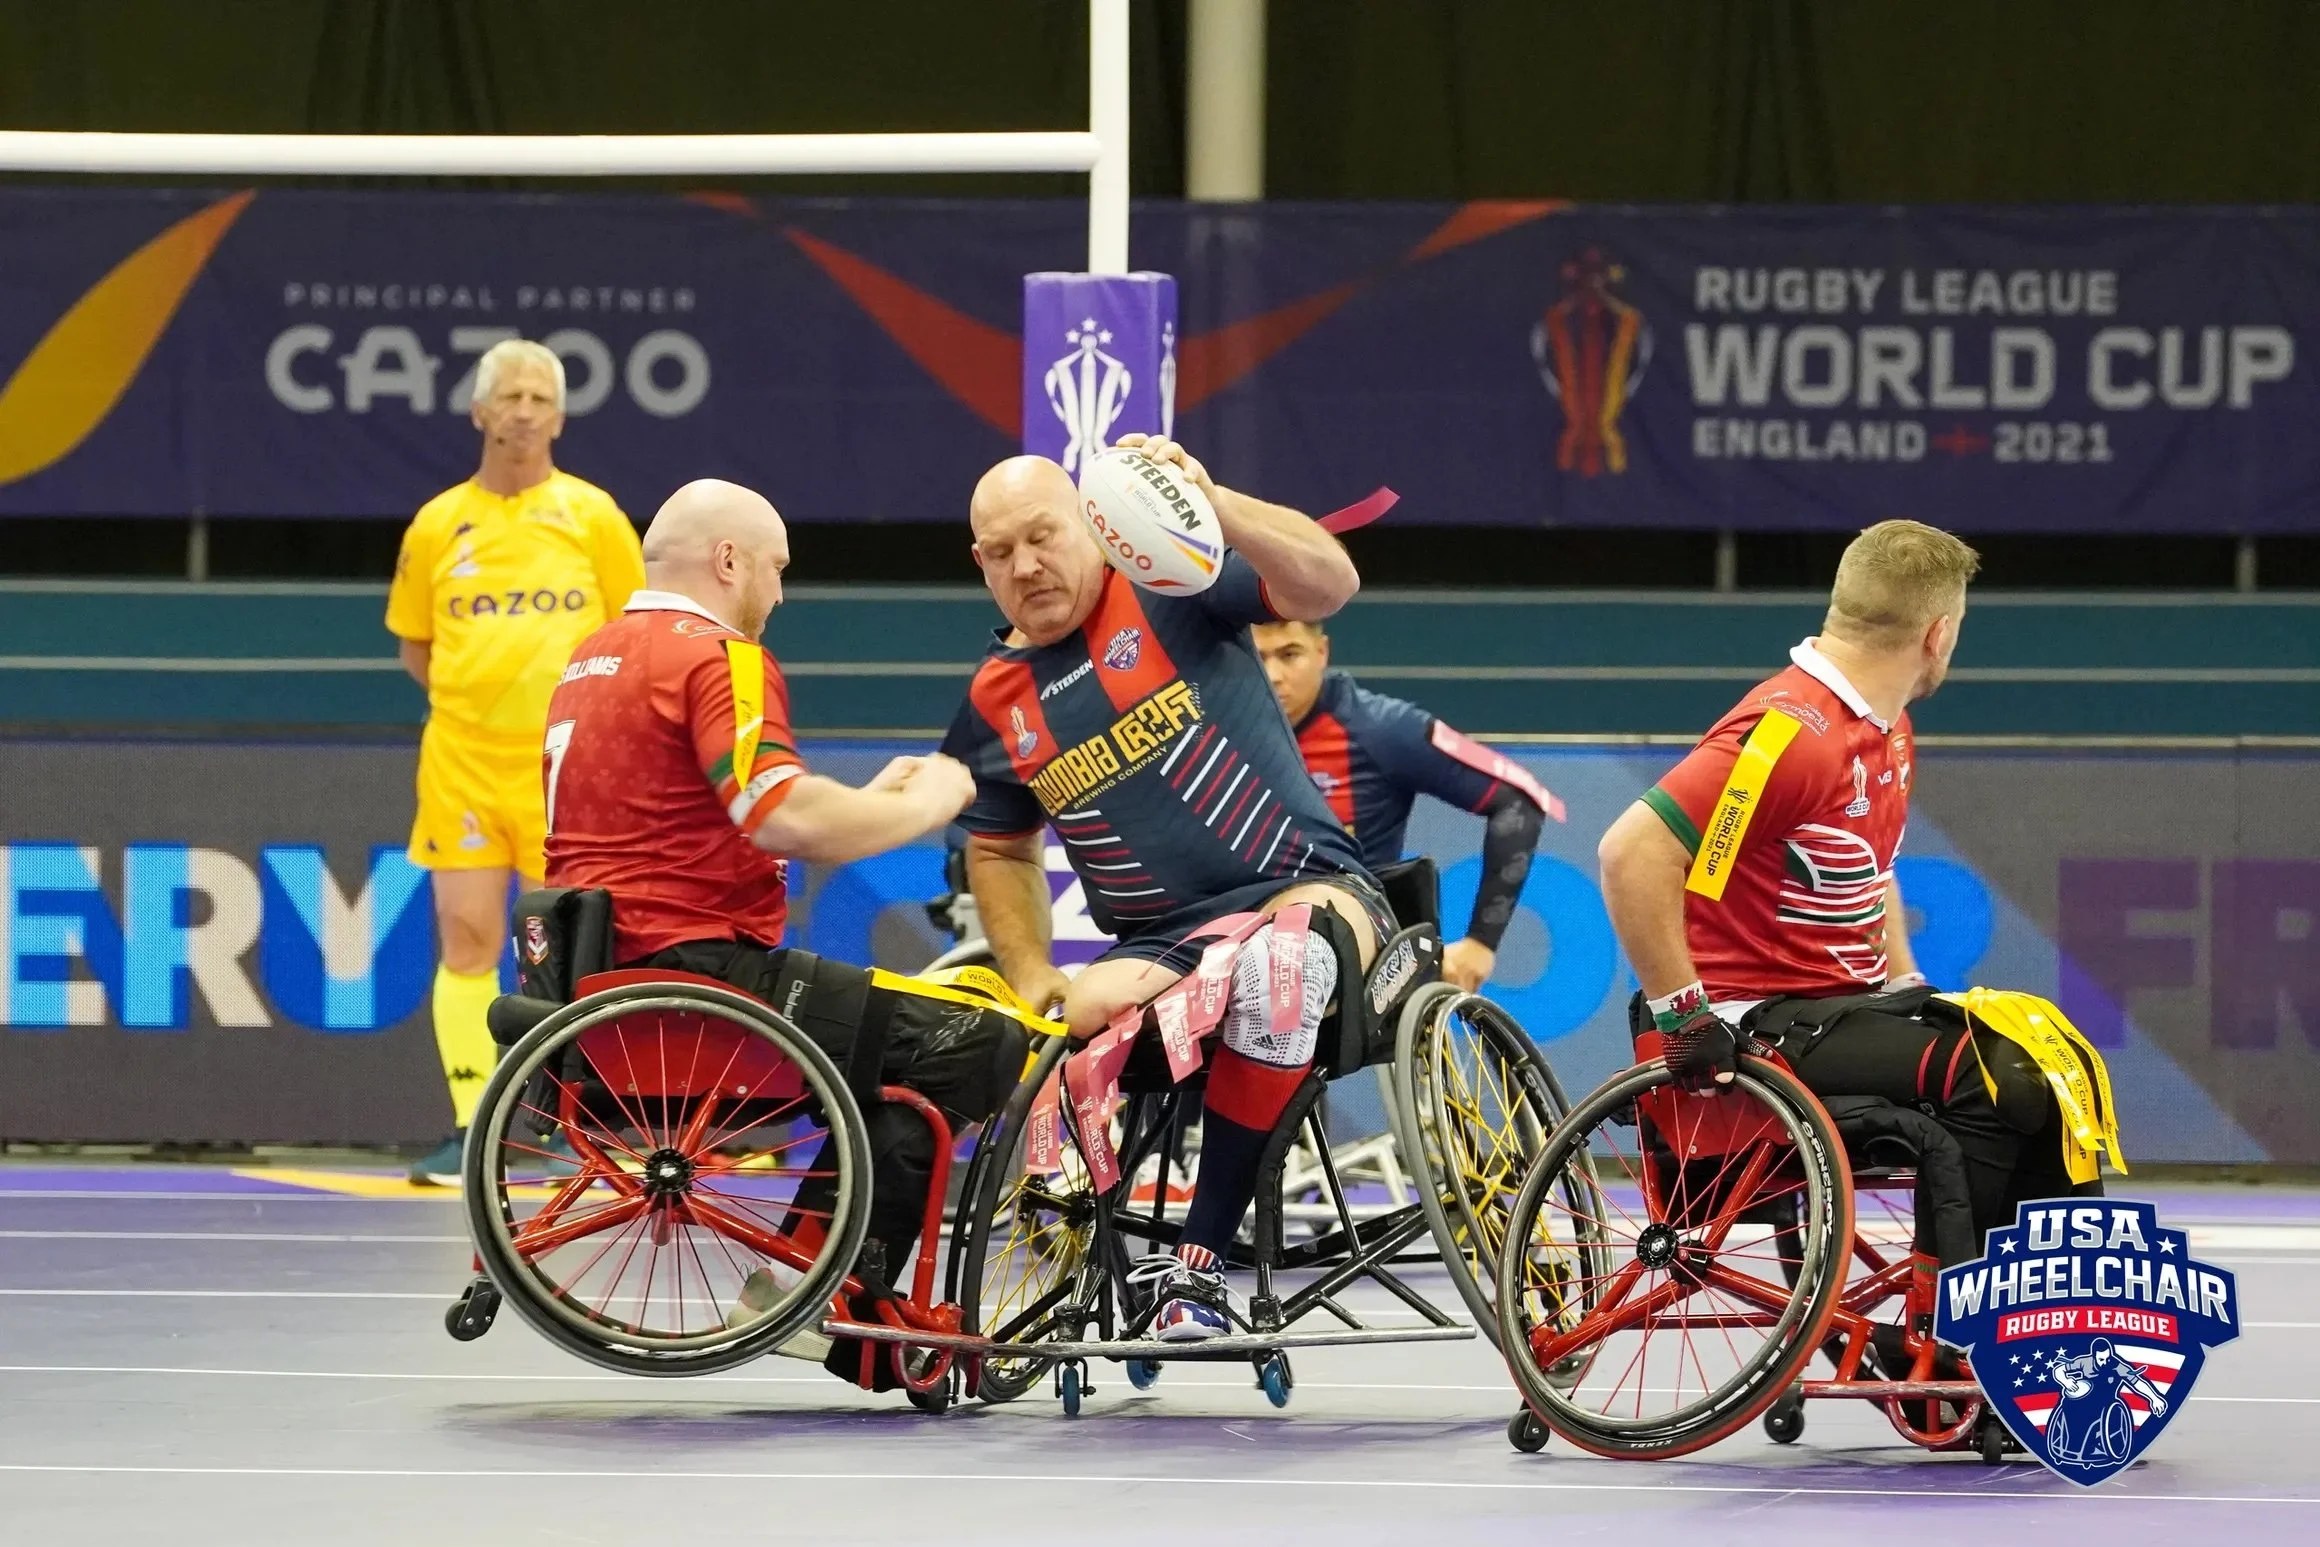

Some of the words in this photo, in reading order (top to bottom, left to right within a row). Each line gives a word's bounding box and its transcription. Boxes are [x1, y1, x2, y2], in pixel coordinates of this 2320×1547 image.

[284, 282, 495, 311] PRINCIPAL
[517, 286, 696, 313] PARTNER
[1695, 266, 1884, 314] RUGBY
[1902, 270, 2118, 316] LEAGUE
[1684, 325, 2056, 410] WORLD
[2086, 328, 2295, 411] CUP
[1693, 419, 1927, 462] ENGLAND
[1994, 422, 2114, 463] 2021
[1119, 453, 1202, 532] STEEDEN
[1086, 499, 1153, 571] CAZOO
[449, 589, 587, 619] CAZOO
[1051, 658, 1095, 696] STEEDEN
[1073, 779, 1117, 810] BREWING
[1118, 746, 1168, 781] COMPANY
[1714, 804, 1730, 833] ENGLAND
[1715, 805, 1740, 850] WORLD
[1734, 810, 1745, 833] RUGBY
[1706, 838, 1716, 852] 2021
[1722, 833, 1737, 859] LEAGUE
[1706, 851, 1721, 876] CUP
[1204, 996, 1216, 1015] CUP
[1280, 983, 1290, 1008] CUP
[1177, 1043, 1190, 1062] CUP
[2056, 1048, 2083, 1087] WORD
[2079, 1089, 2089, 1116] CUP
[1037, 1114, 1048, 1149] WORLD
[1037, 1149, 1048, 1165] CUP
[1095, 1152, 1109, 1174] CUP
[1802, 1121, 1834, 1236] SPINERGY
